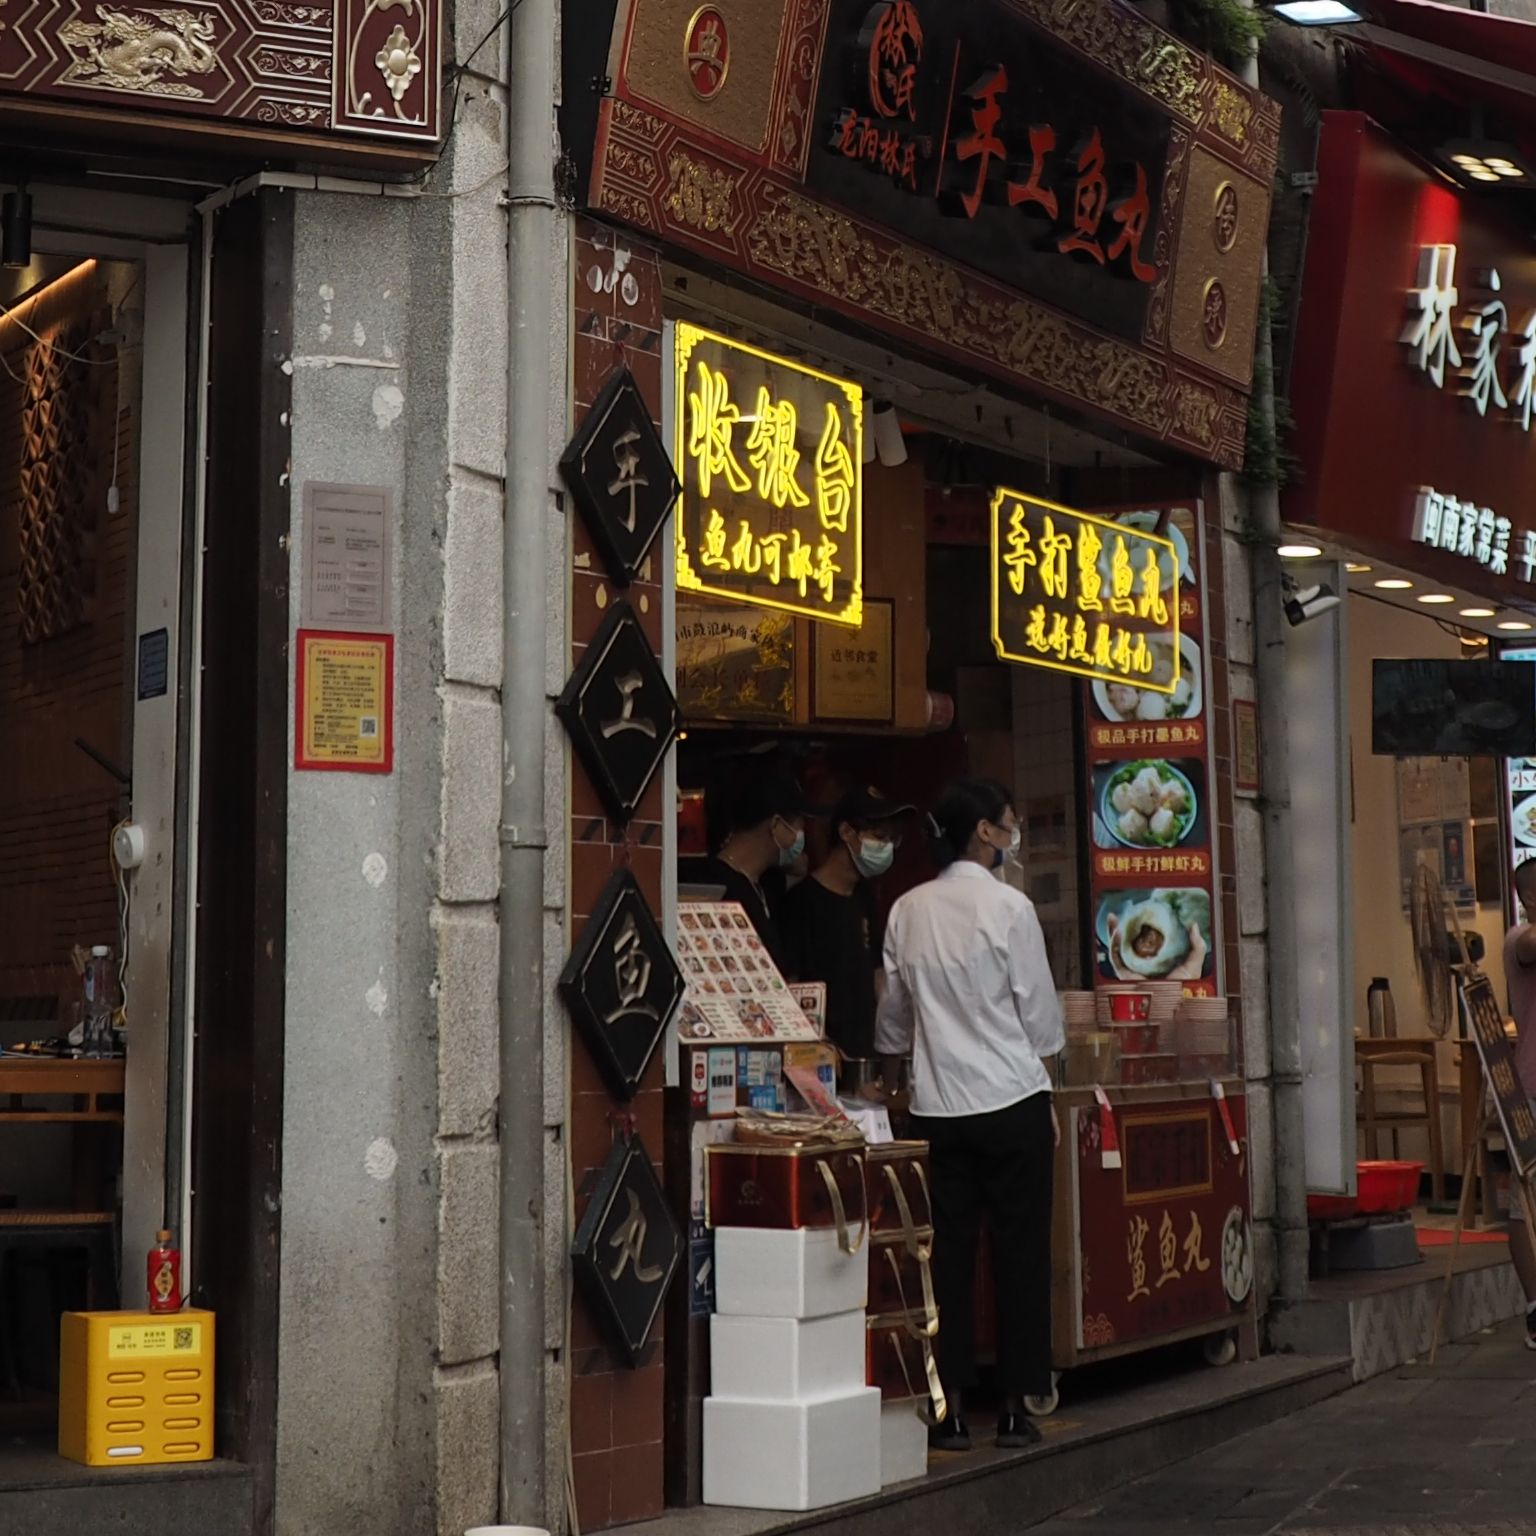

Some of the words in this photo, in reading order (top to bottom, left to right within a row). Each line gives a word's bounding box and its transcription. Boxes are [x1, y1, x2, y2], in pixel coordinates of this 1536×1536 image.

[957, 64, 1158, 283] 手工鱼丸
[1204, 192, 1239, 343] 传承
[689, 361, 855, 532] 收银台
[700, 509, 842, 603] 鱼丸可邮寄
[1002, 503, 1169, 626] 手打鲨鱼丸
[1420, 491, 1513, 576] 闽南家常菜
[1097, 725, 1201, 745] 极品手打墨鱼丸
[601, 427, 660, 1285] 手工鱼丸
[1101, 854, 1206, 873] 极鲜手打鲜虾丸
[1127, 1209, 1211, 1303] 鲨鱼丸
